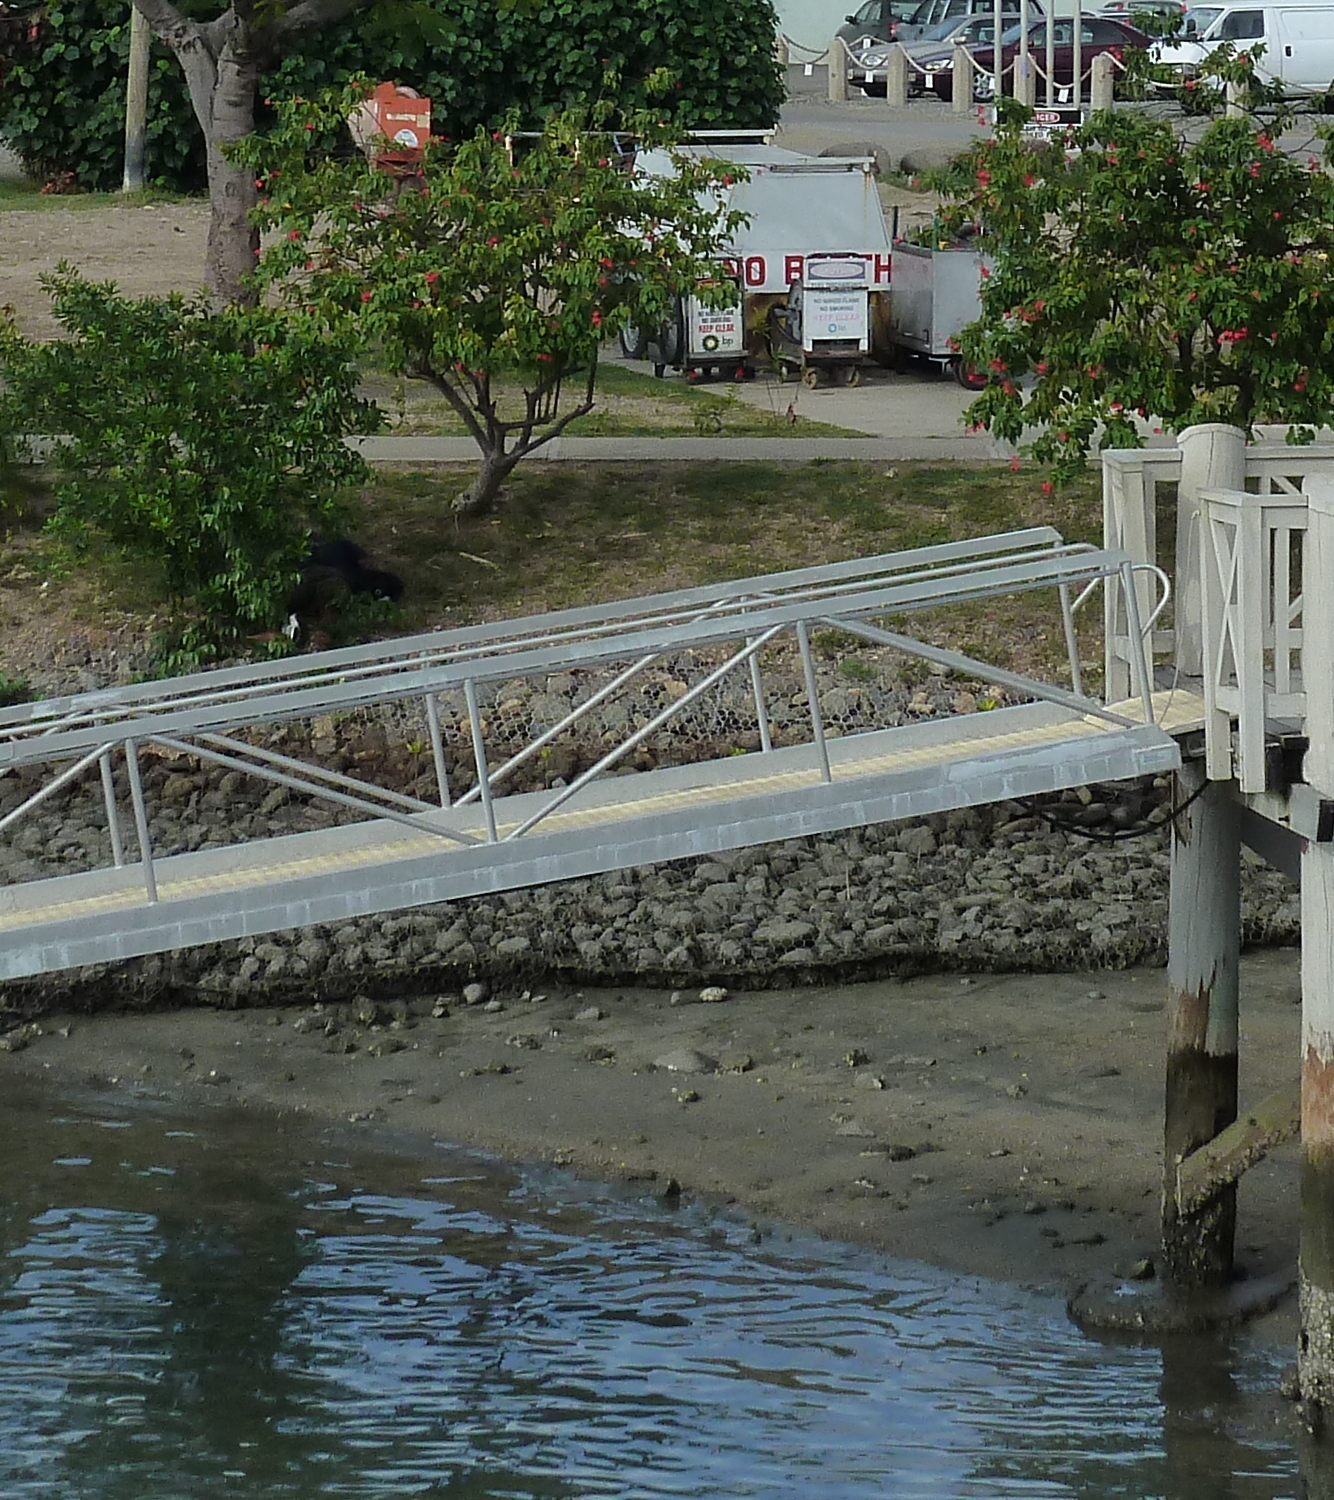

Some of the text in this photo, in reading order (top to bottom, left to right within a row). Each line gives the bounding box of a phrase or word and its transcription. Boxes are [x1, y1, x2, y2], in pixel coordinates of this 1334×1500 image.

[698, 324, 734, 333] KEEP CLEAR
[722, 335, 734, 347] bp
